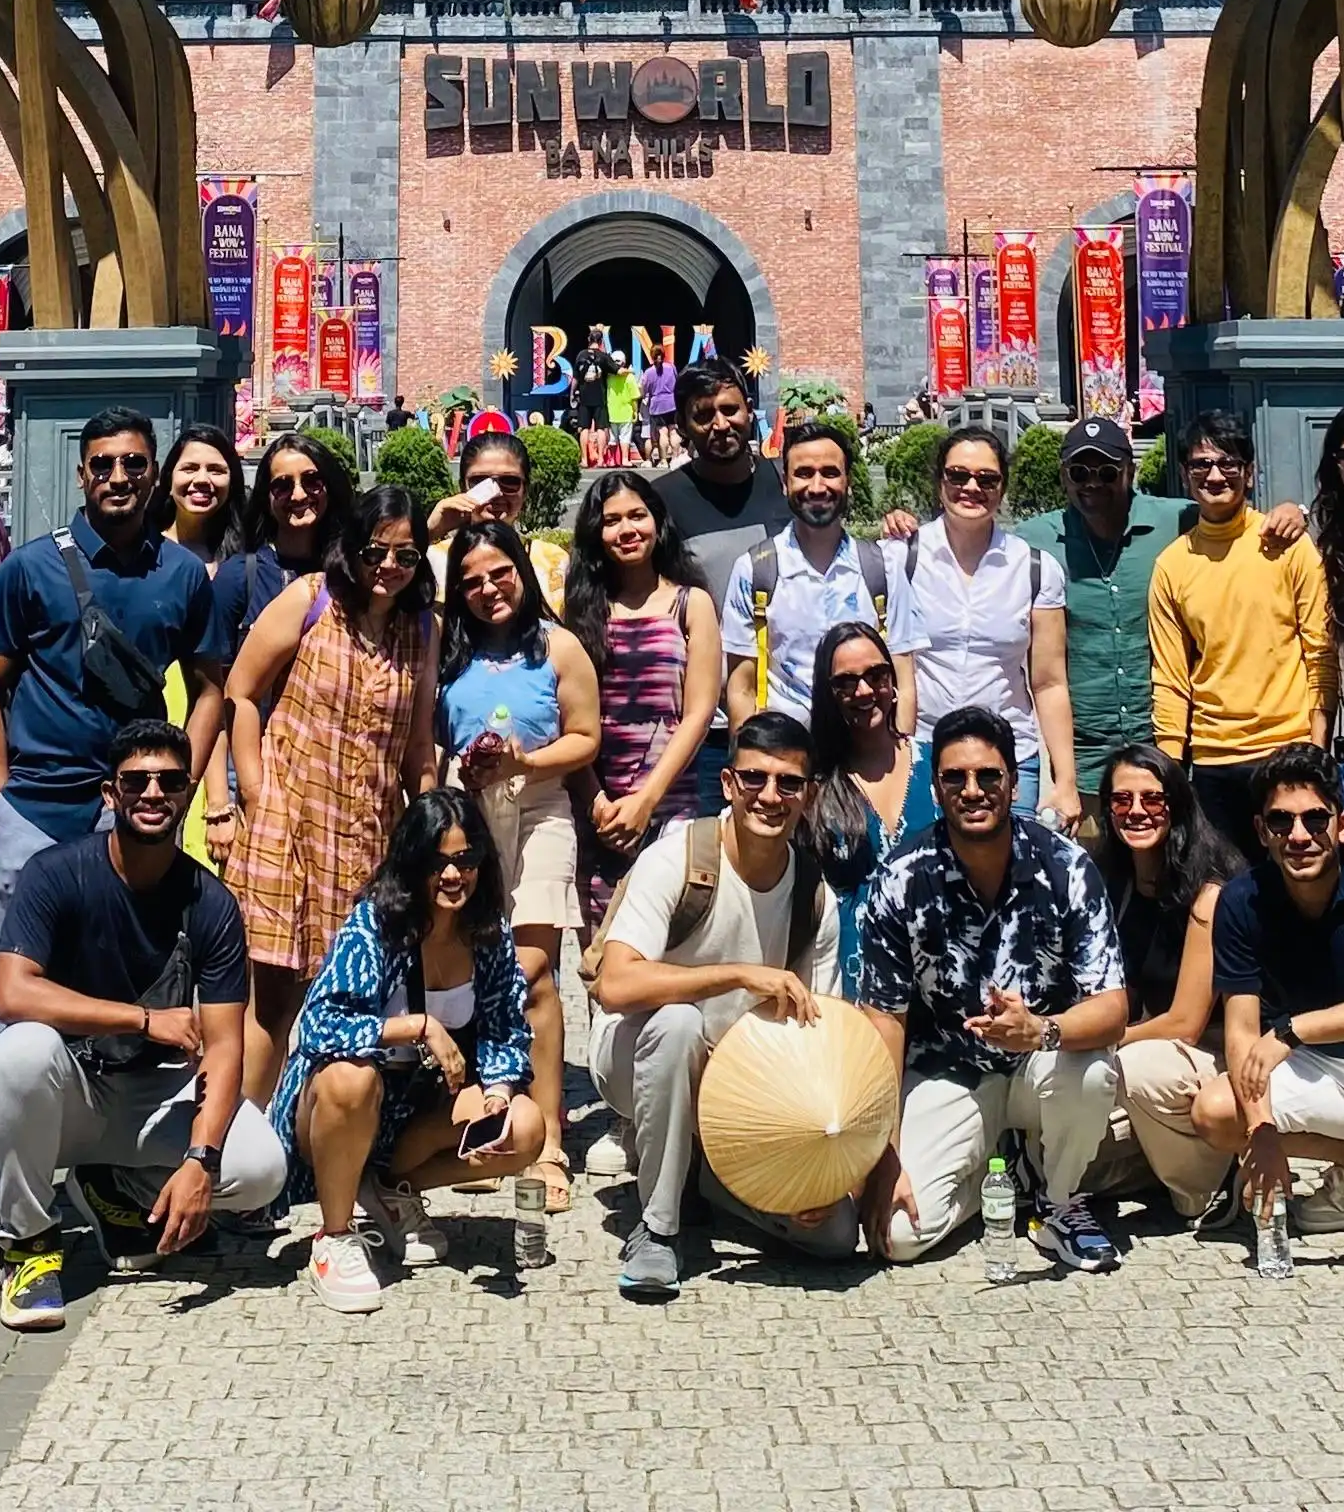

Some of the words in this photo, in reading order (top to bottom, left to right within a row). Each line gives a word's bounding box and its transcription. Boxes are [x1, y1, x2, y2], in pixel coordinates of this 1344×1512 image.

[424, 53, 563, 130] SUN
[571, 51, 832, 127] WORLD
[546, 139, 580, 163] BA
[593, 137, 632, 163] NA
[644, 138, 713, 163] HILLS
[1148, 218, 1178, 232] BANA
[214, 225, 244, 237] BANA
[1153, 232, 1174, 242] WOW
[219, 238, 239, 248] WOW
[1144, 242, 1184, 253] FESTIVAL
[209, 248, 248, 259] FESTIVAL
[1005, 264, 1028, 274] BANA
[1086, 266, 1112, 278] BANA
[280, 277, 303, 288] BANA
[1002, 281, 1032, 289] FESTIVAL
[1084, 287, 1118, 297] FESTIVAL
[277, 295, 305, 303] FESTIVAL
[325, 337, 345, 345] BANA
